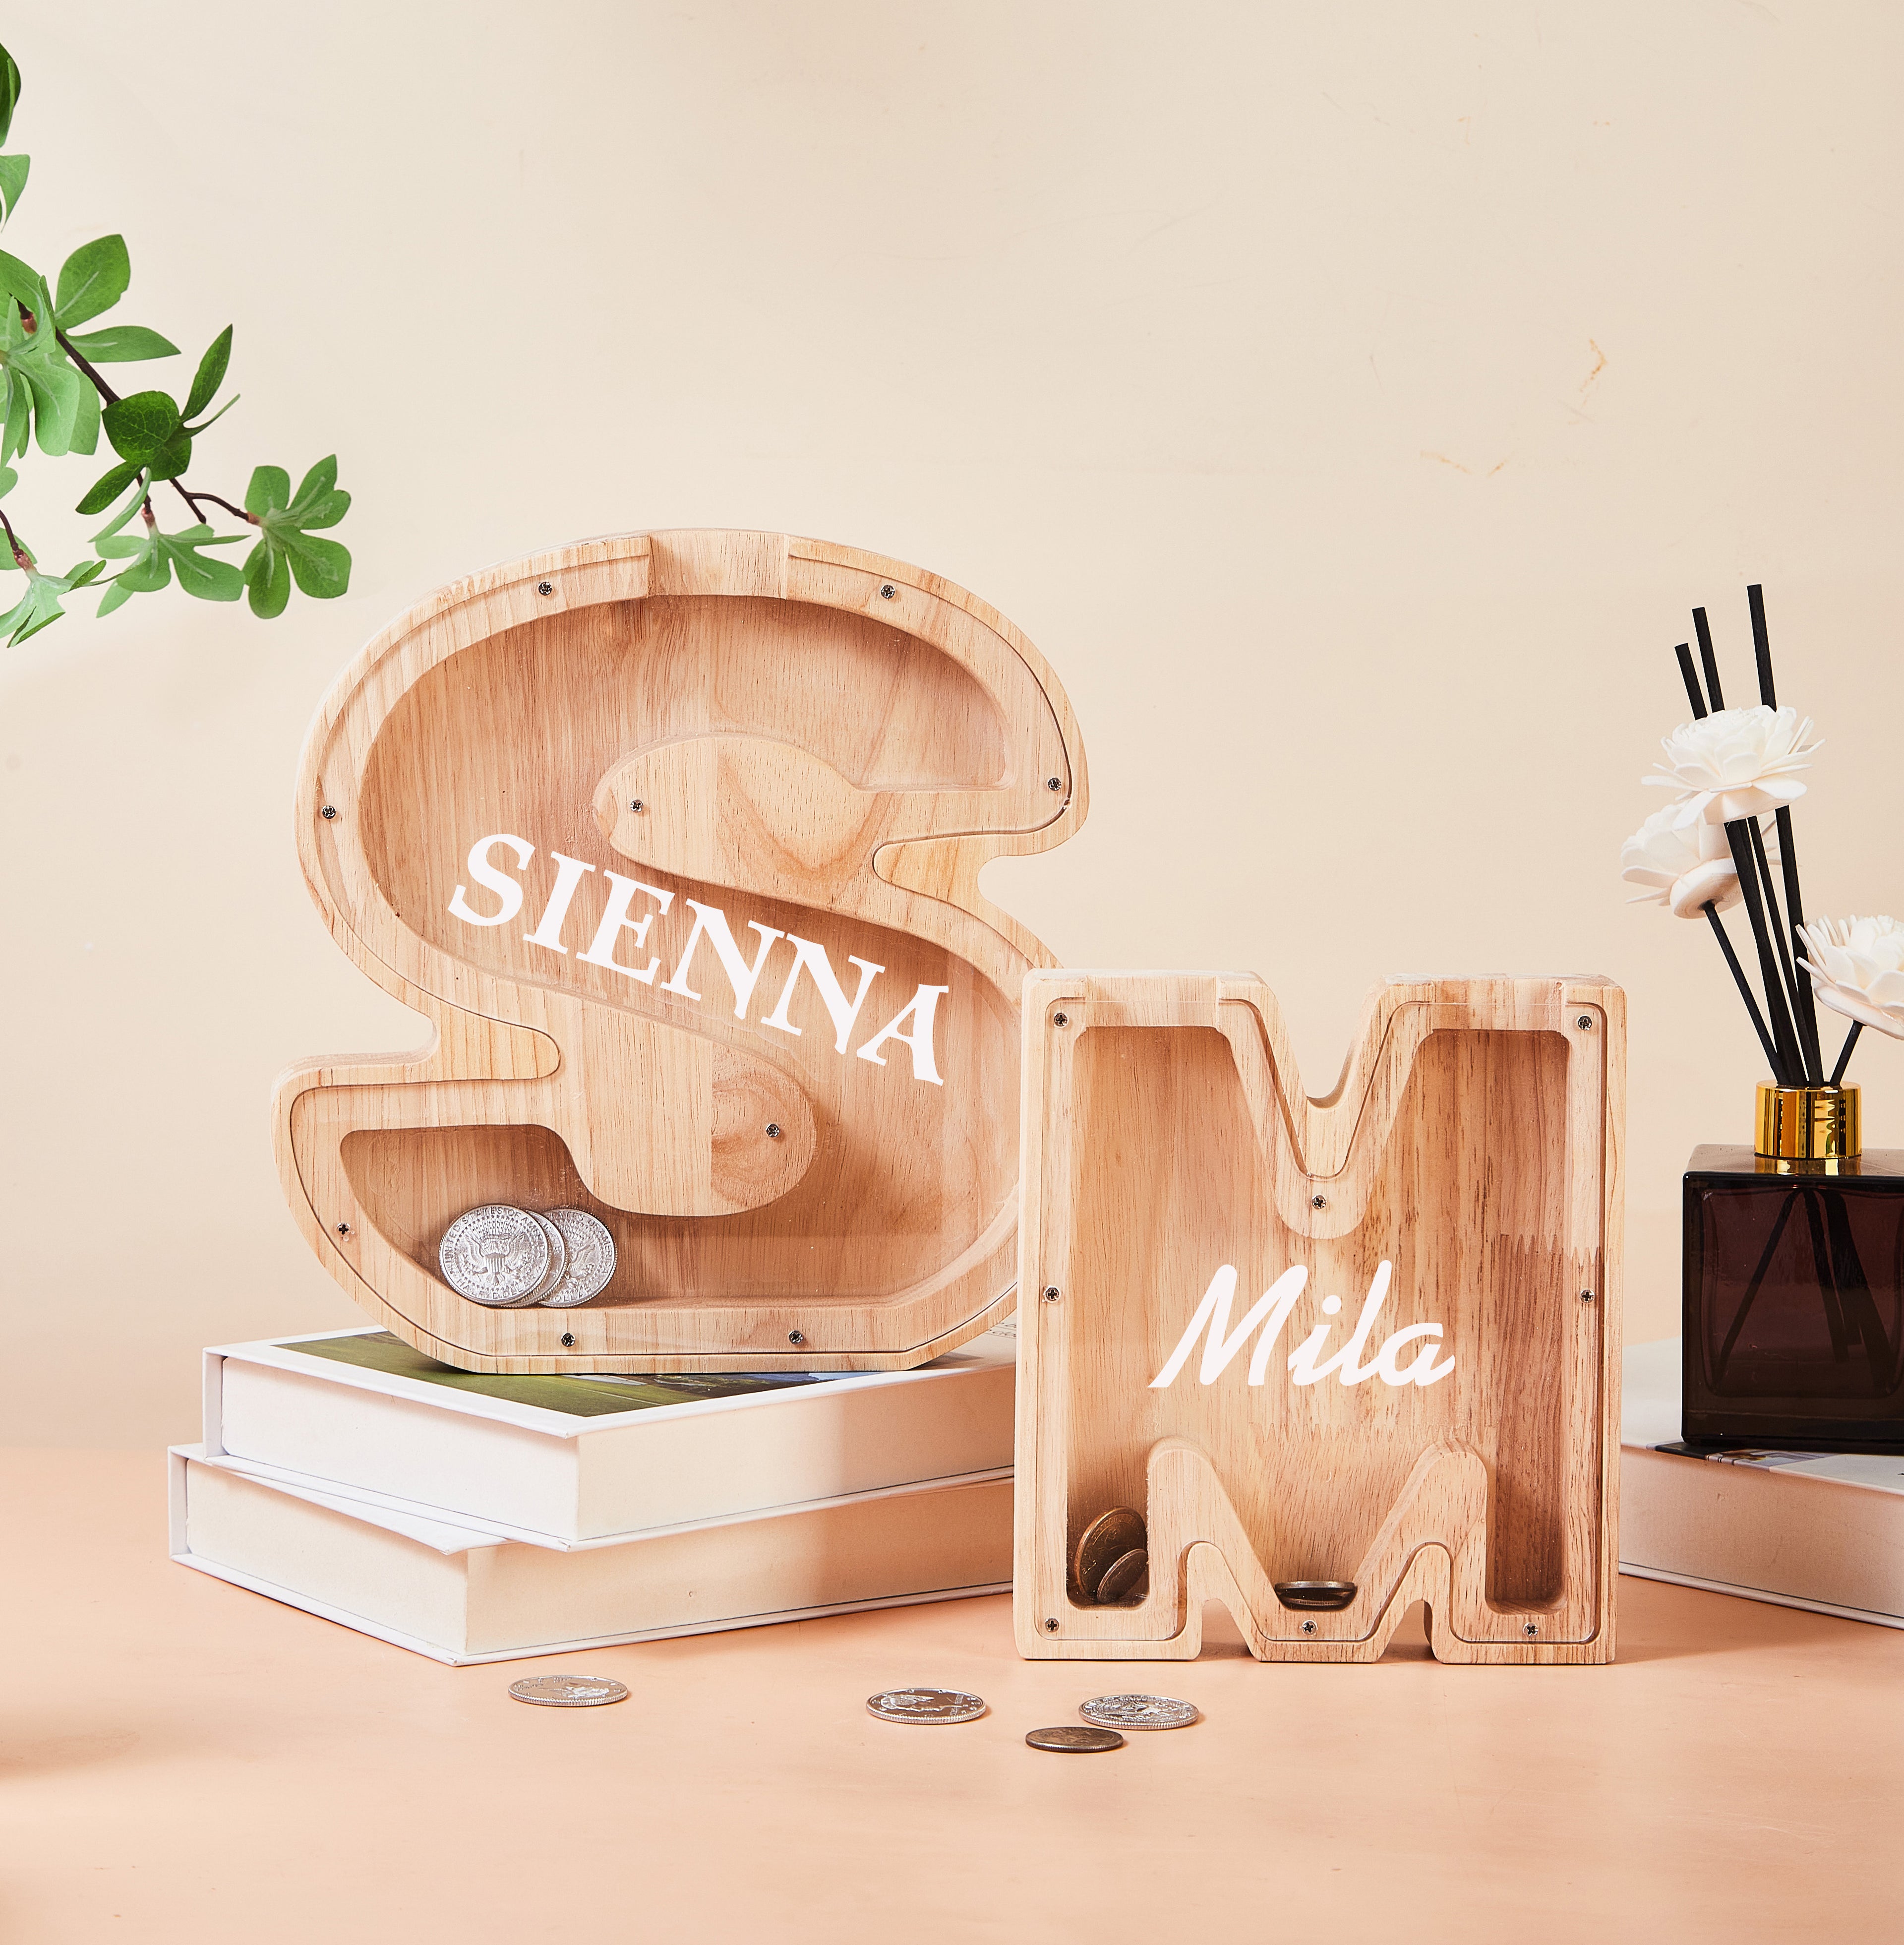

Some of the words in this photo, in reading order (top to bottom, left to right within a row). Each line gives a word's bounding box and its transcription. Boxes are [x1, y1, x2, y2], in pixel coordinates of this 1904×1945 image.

[448, 834, 949, 1086] SIENNA
[444, 1224, 461, 1264] UNITED
[462, 1207, 502, 1224] STATES
[507, 1209, 522, 1218] OF
[554, 1285, 594, 1303] OLLAR
[1146, 1260, 1456, 1388] Mila
